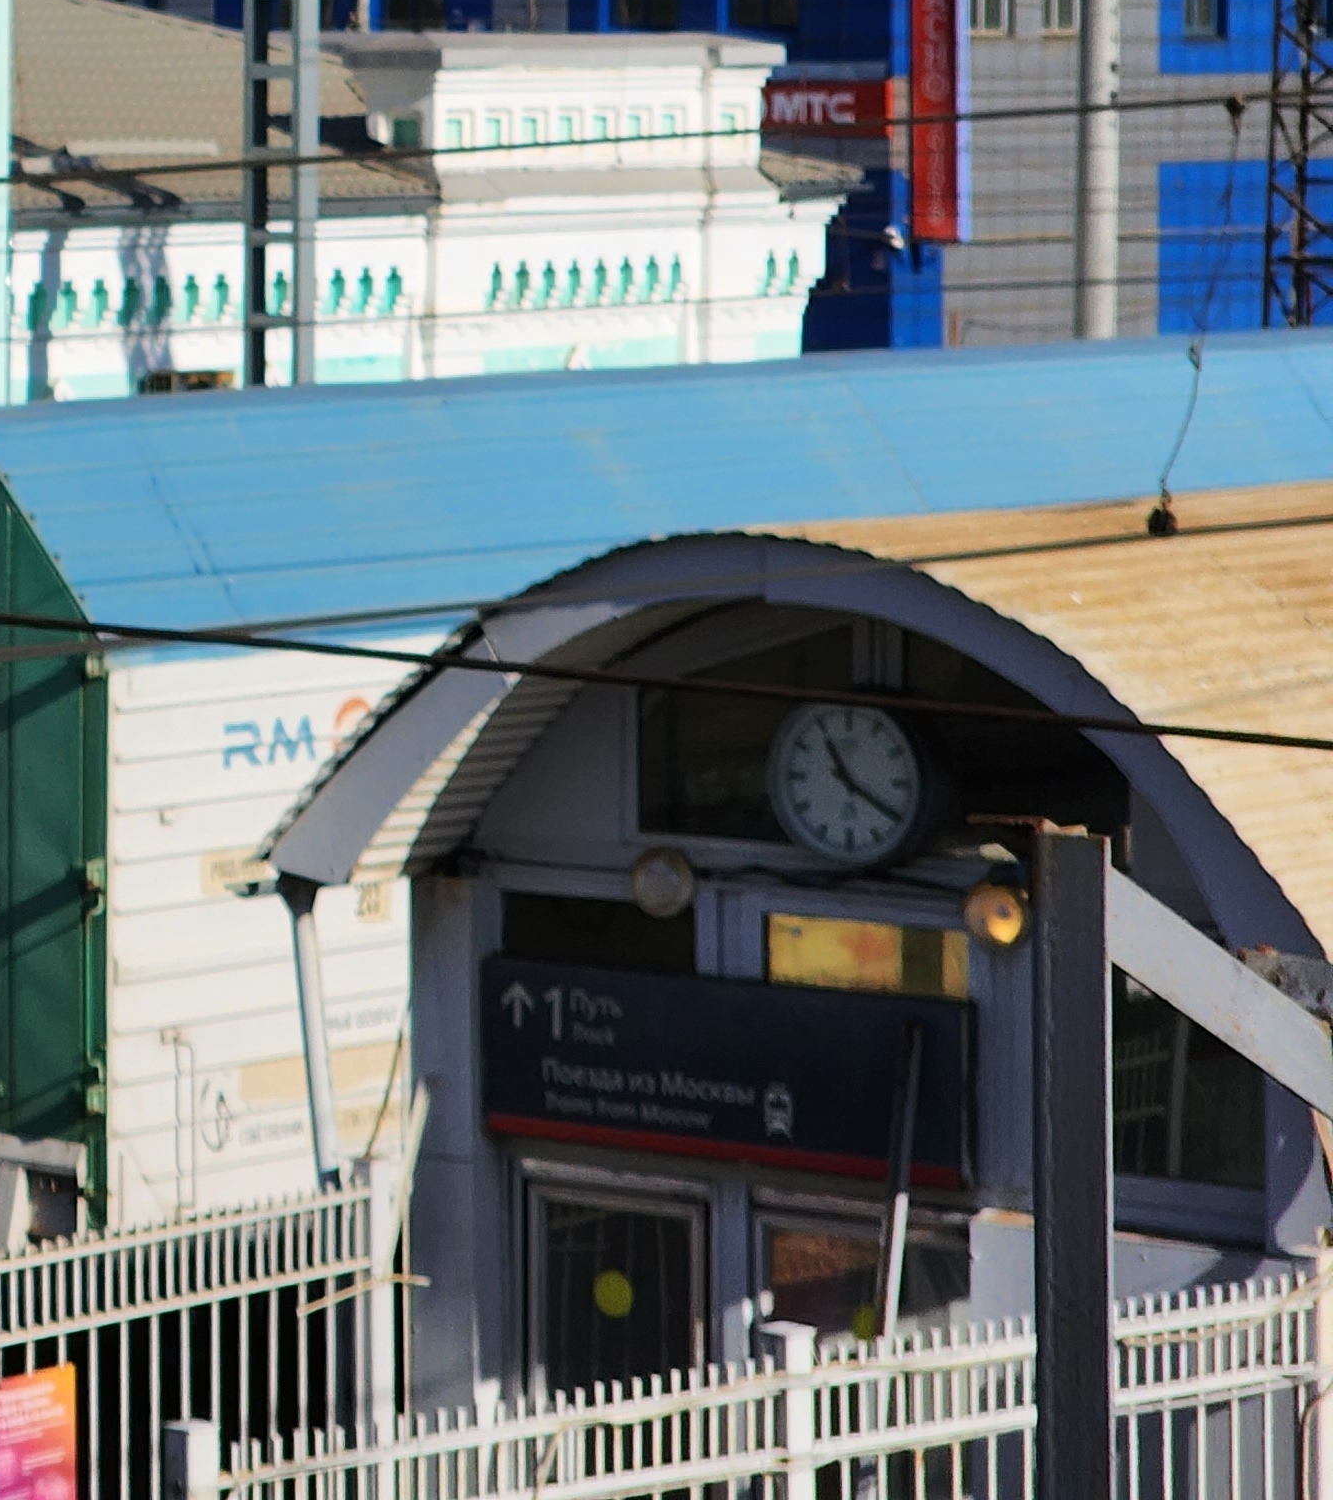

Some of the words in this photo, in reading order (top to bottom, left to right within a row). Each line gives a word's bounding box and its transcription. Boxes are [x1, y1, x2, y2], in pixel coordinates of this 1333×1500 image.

[771, 91, 856, 124] МТС
[222, 716, 316, 770] RM
[542, 985, 564, 1041] 1
[569, 987, 624, 1021] Путь
[541, 1055, 624, 1091] Поезда
[627, 1071, 657, 1095] из
[660, 1070, 756, 1106] Москвы
